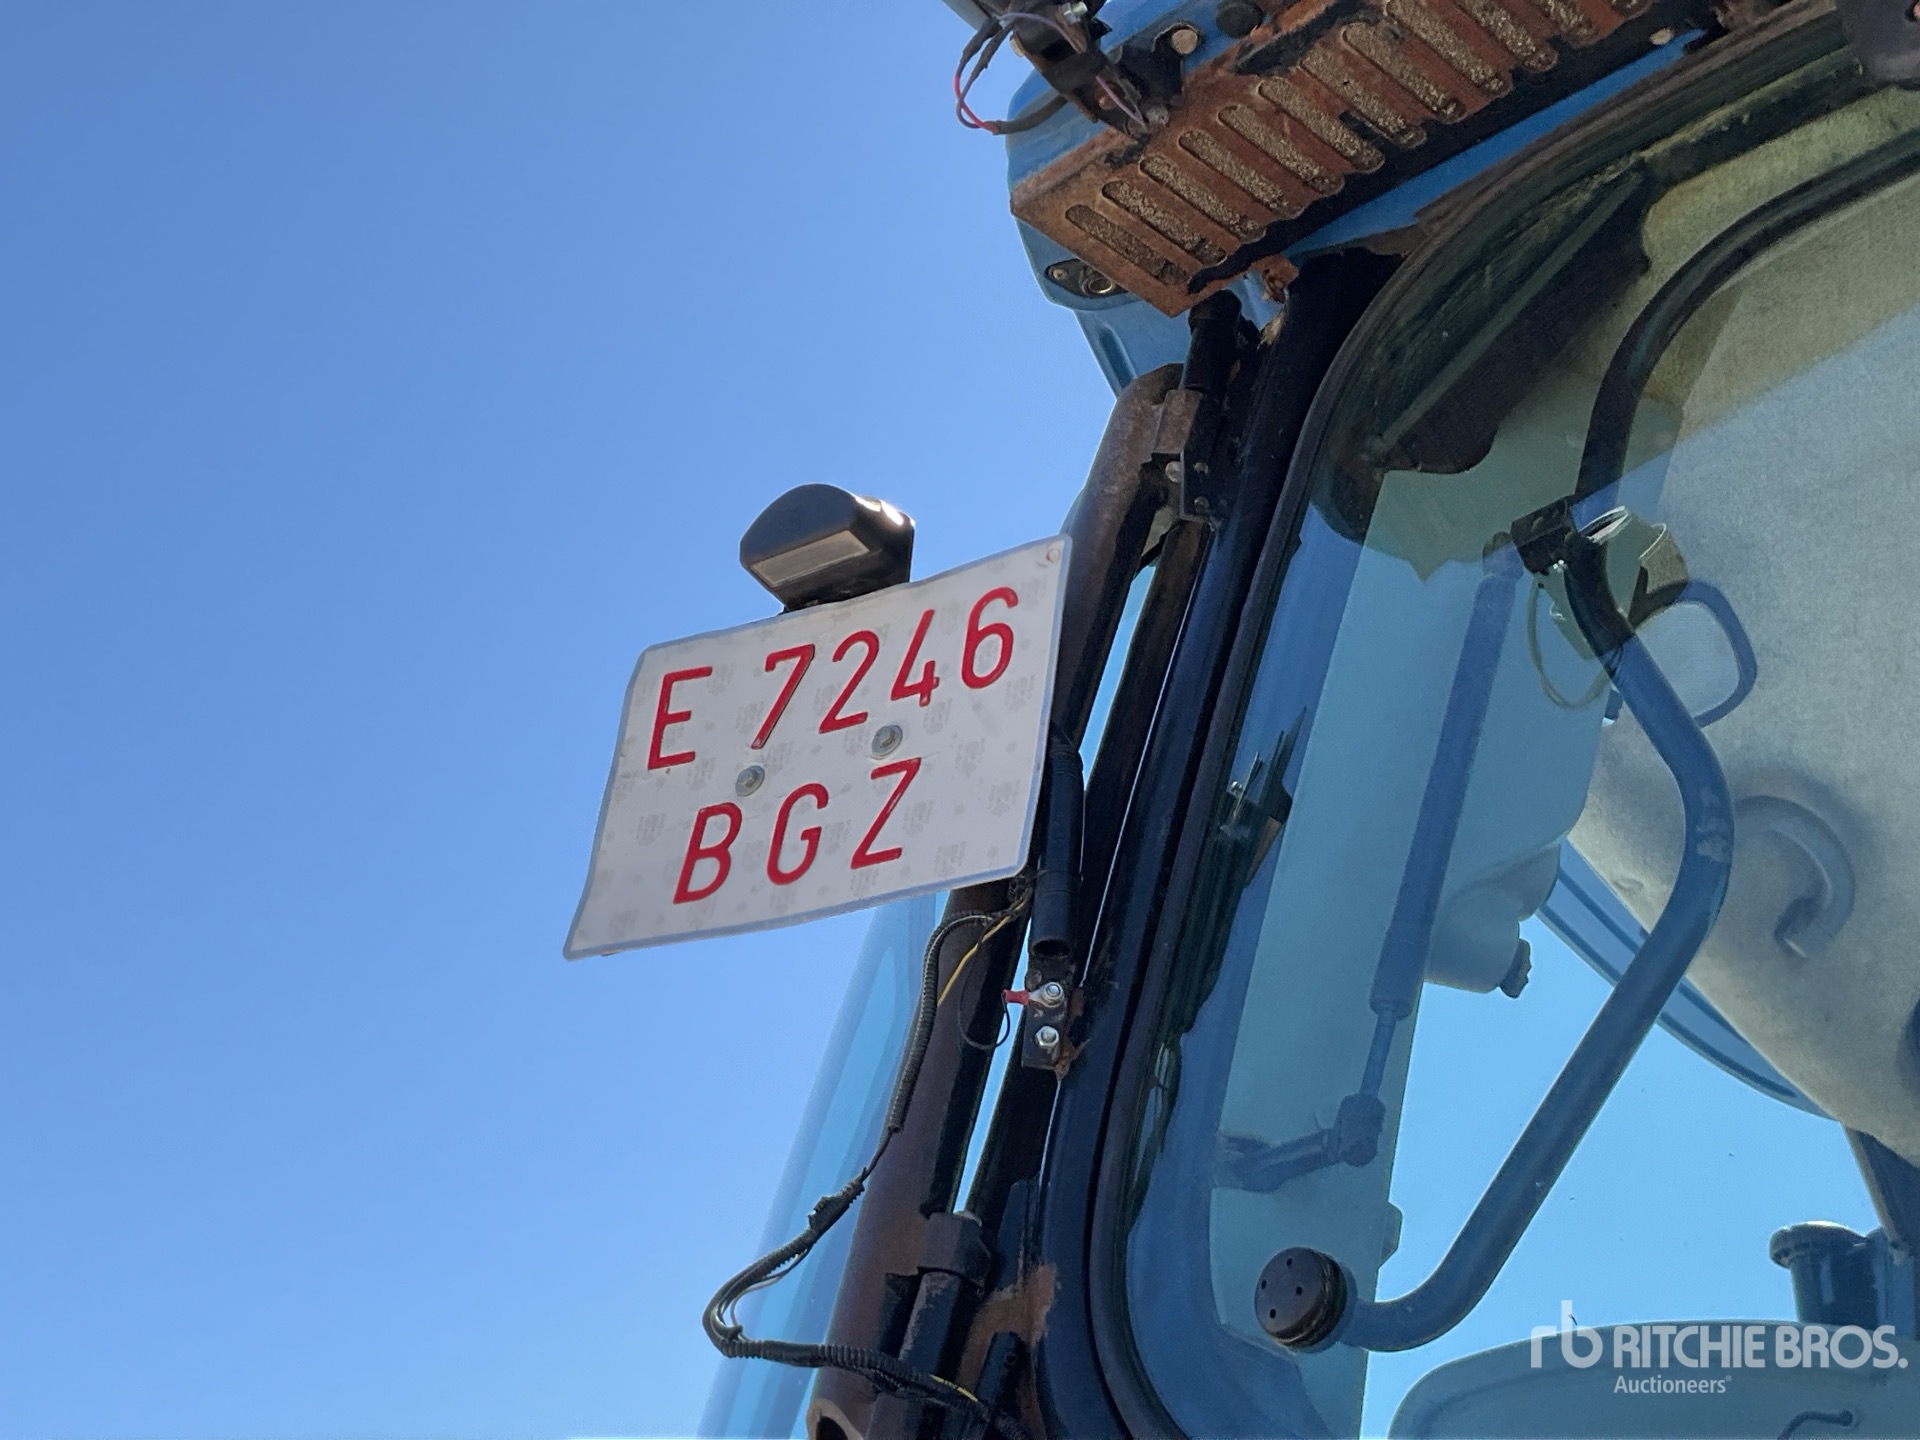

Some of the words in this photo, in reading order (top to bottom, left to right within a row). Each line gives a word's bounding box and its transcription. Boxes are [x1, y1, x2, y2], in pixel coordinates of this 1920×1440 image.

[647, 666, 712, 770] E
[752, 586, 1018, 750] 7246
[673, 758, 922, 904] BGZ
